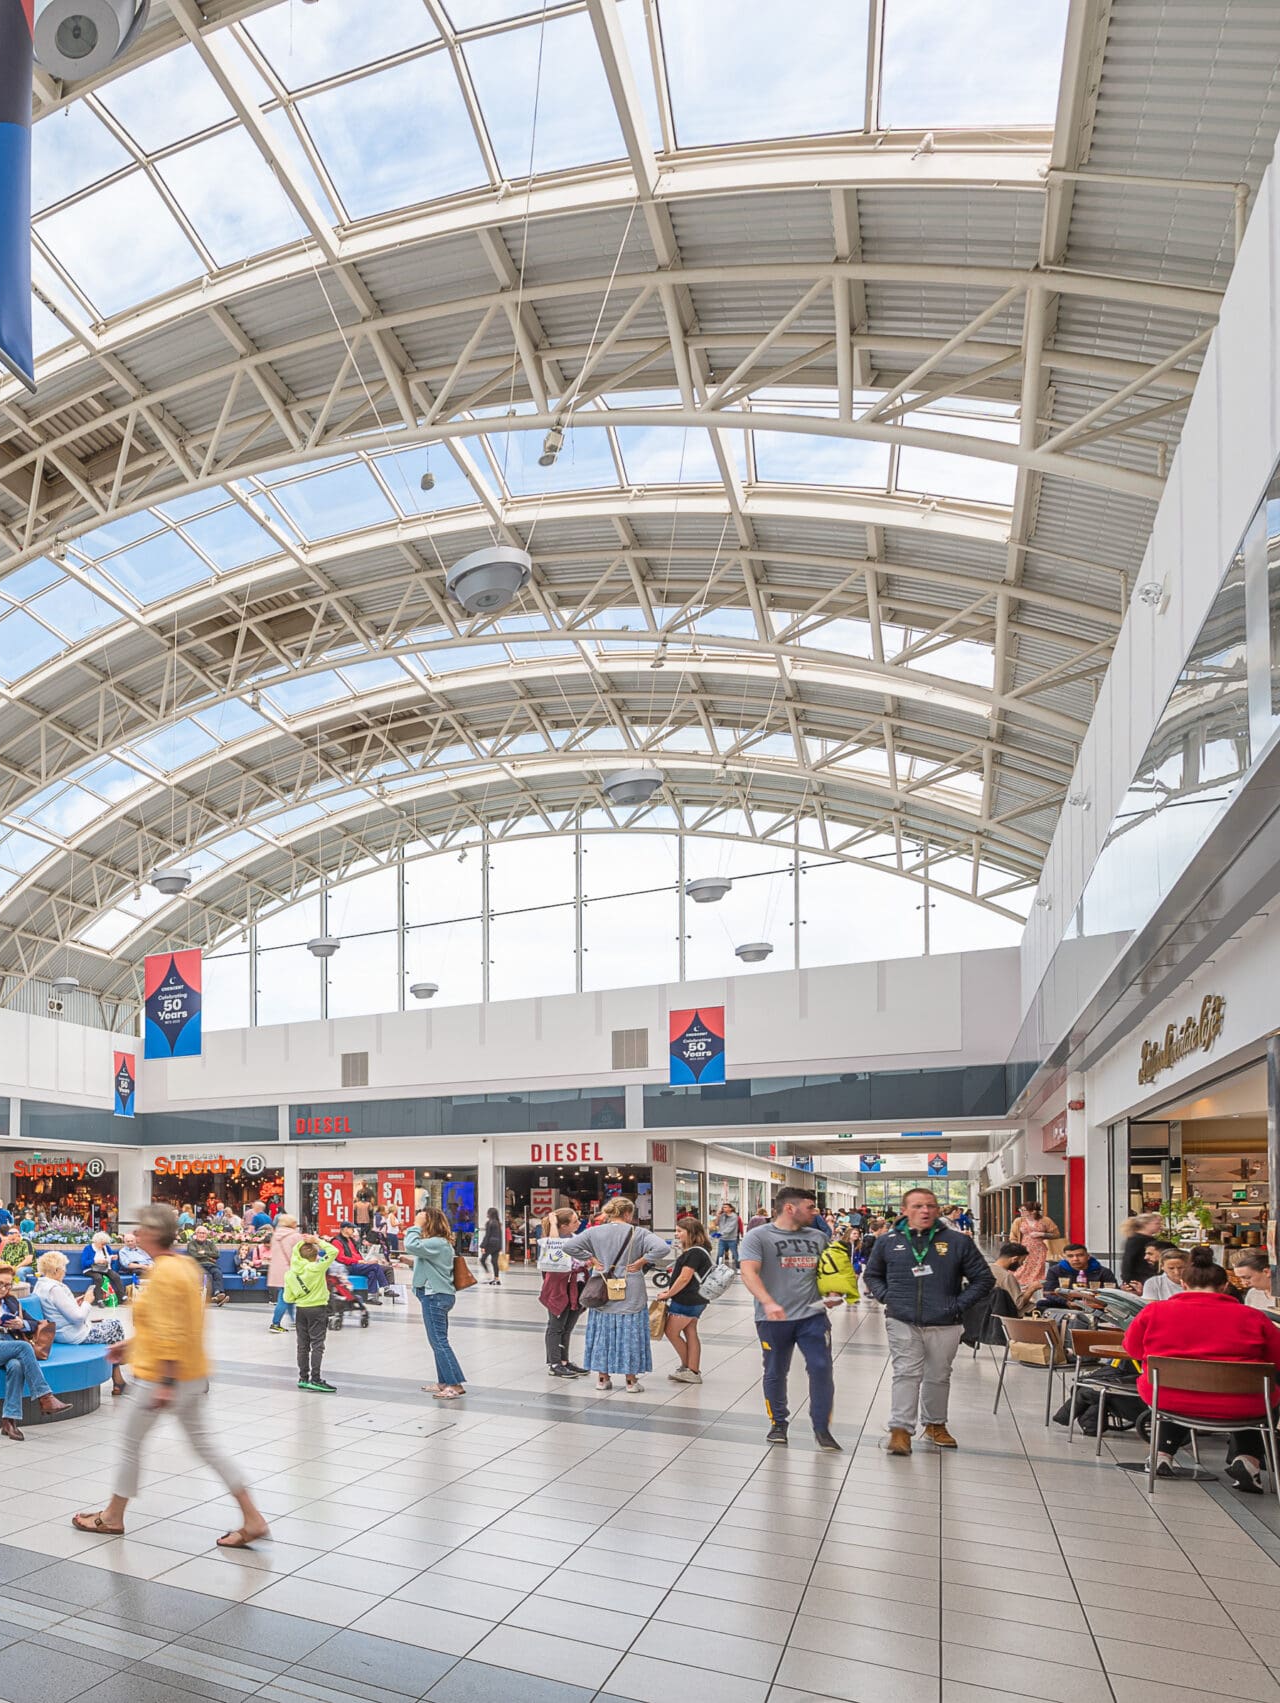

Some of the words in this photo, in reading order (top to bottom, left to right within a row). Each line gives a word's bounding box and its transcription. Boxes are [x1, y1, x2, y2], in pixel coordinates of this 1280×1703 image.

[163, 999, 182, 1011] 50
[158, 1010, 188, 1021] Years
[683, 1050, 712, 1058] Years
[688, 1041, 706, 1051] 50
[295, 1116, 353, 1135] DIESEL
[530, 1141, 604, 1163] DIESEL
[13, 1158, 88, 1181] Superdry
[154, 1155, 244, 1179] Superdry
[775, 1238, 820, 1257] PTH
